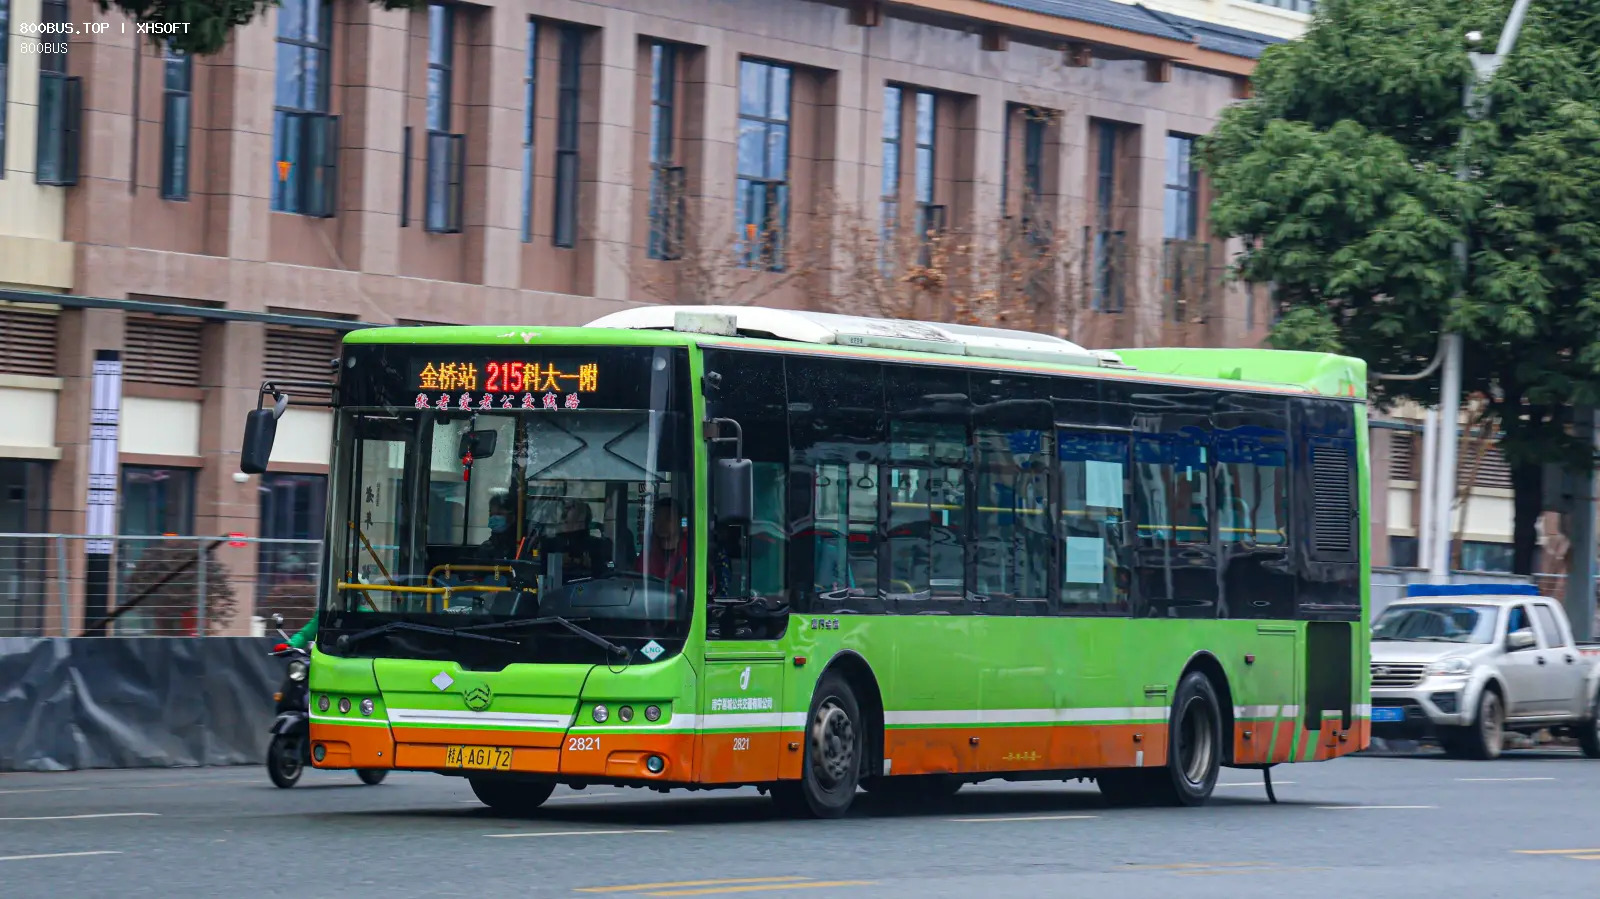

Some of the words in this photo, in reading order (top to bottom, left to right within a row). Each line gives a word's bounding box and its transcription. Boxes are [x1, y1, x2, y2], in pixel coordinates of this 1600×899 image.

[419, 362, 477, 390] 金桥站
[485, 362, 523, 392] 215
[415, 392, 580, 411] 敬老爱老公交线路
[568, 737, 600, 751] 2821
[733, 737, 750, 751] 2821
